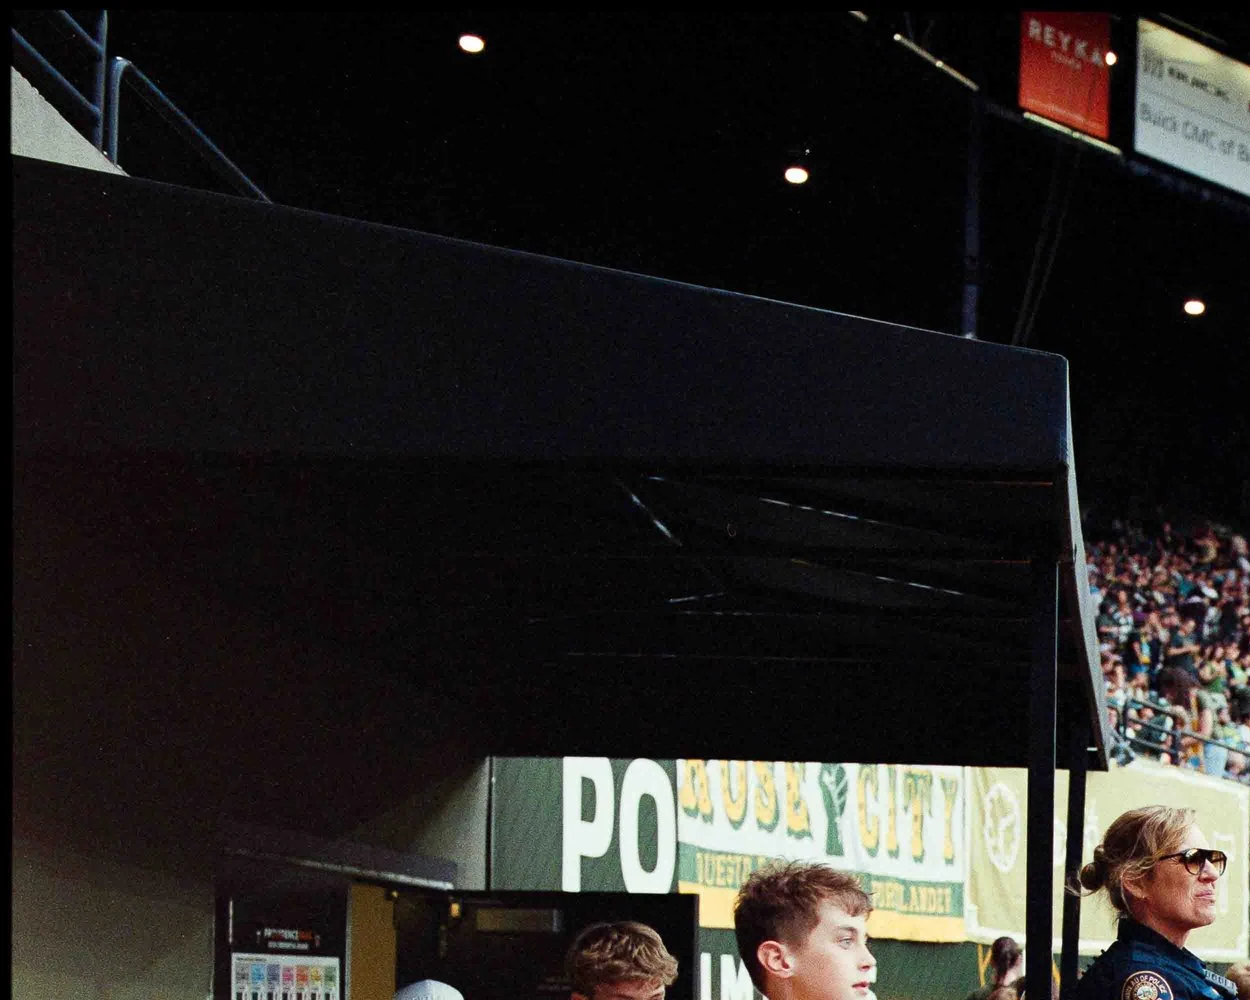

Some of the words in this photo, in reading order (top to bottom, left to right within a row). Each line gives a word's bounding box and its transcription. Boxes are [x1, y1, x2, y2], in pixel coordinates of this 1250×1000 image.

[1028, 17, 1104, 67] REYKA
[1139, 102, 1179, 133] Buick
[1219, 139, 1235, 155] of
[679, 759, 812, 841] ROSE
[855, 763, 961, 867] CITY
[1148, 975, 1168, 995] POLICE
